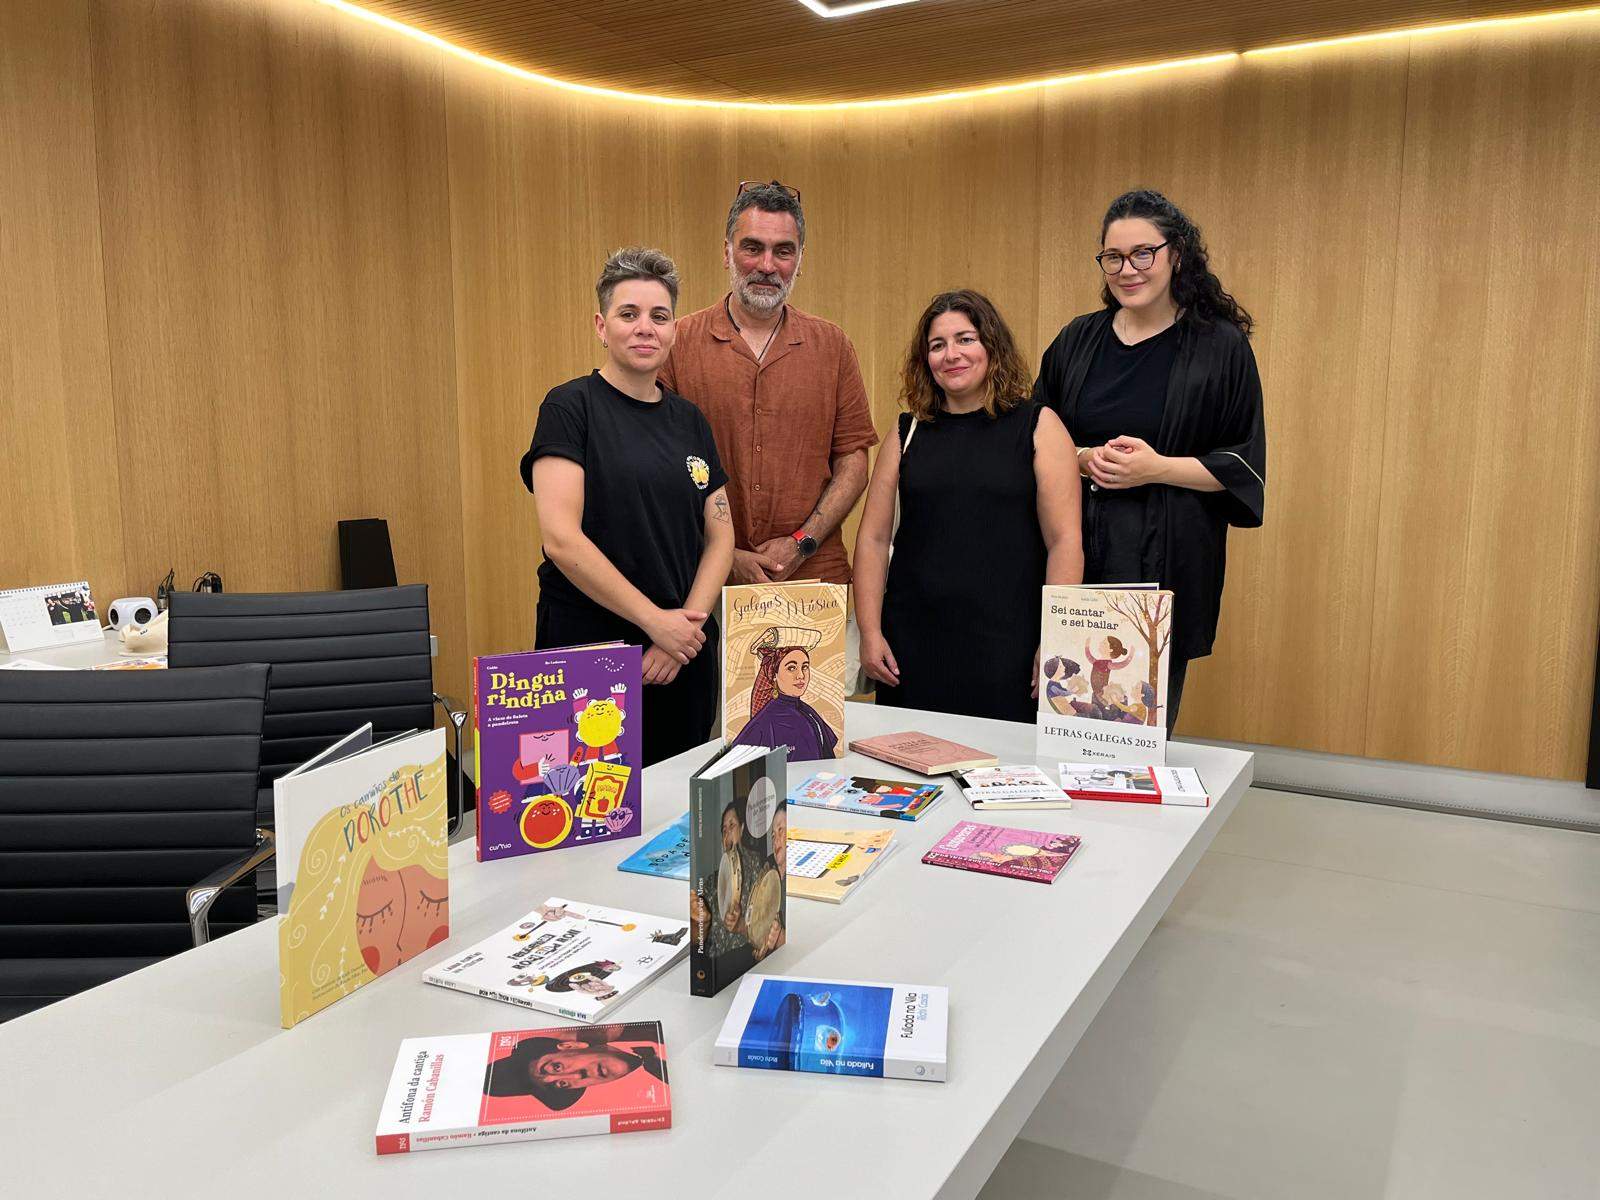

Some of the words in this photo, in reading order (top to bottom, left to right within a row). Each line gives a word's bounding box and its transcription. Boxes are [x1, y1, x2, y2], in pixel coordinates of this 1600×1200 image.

[1050, 605, 1067, 614] Sei
[1069, 607, 1105, 618] cantar
[1069, 619, 1085, 628] sei
[1087, 619, 1119, 631] bailar
[490, 668, 565, 692] Dingui
[486, 688, 567, 710] rindiña
[1044, 726, 1083, 739] LETRAS
[1084, 731, 1133, 746] GALEGAS
[1134, 738, 1158, 749] 2025
[340, 804, 352, 818] Os
[697, 878, 705, 897] Mens
[697, 898, 704, 907] de
[904, 992, 917, 1004] Vila
[906, 1004, 916, 1014] na
[901, 1014, 915, 1039] Fuliada
[413, 1050, 429, 1077] cantiga
[764, 1055, 779, 1063] Richi
[820, 1058, 835, 1067] Vila
[835, 1059, 846, 1067] na
[847, 1061, 875, 1070] Fuliada
[426, 1054, 445, 1092] Cabanillas
[407, 1077, 420, 1087] da
[399, 1087, 418, 1124] Antífona
[418, 1092, 435, 1123] Ramón
[416, 1135, 449, 1143] Cabanillas
